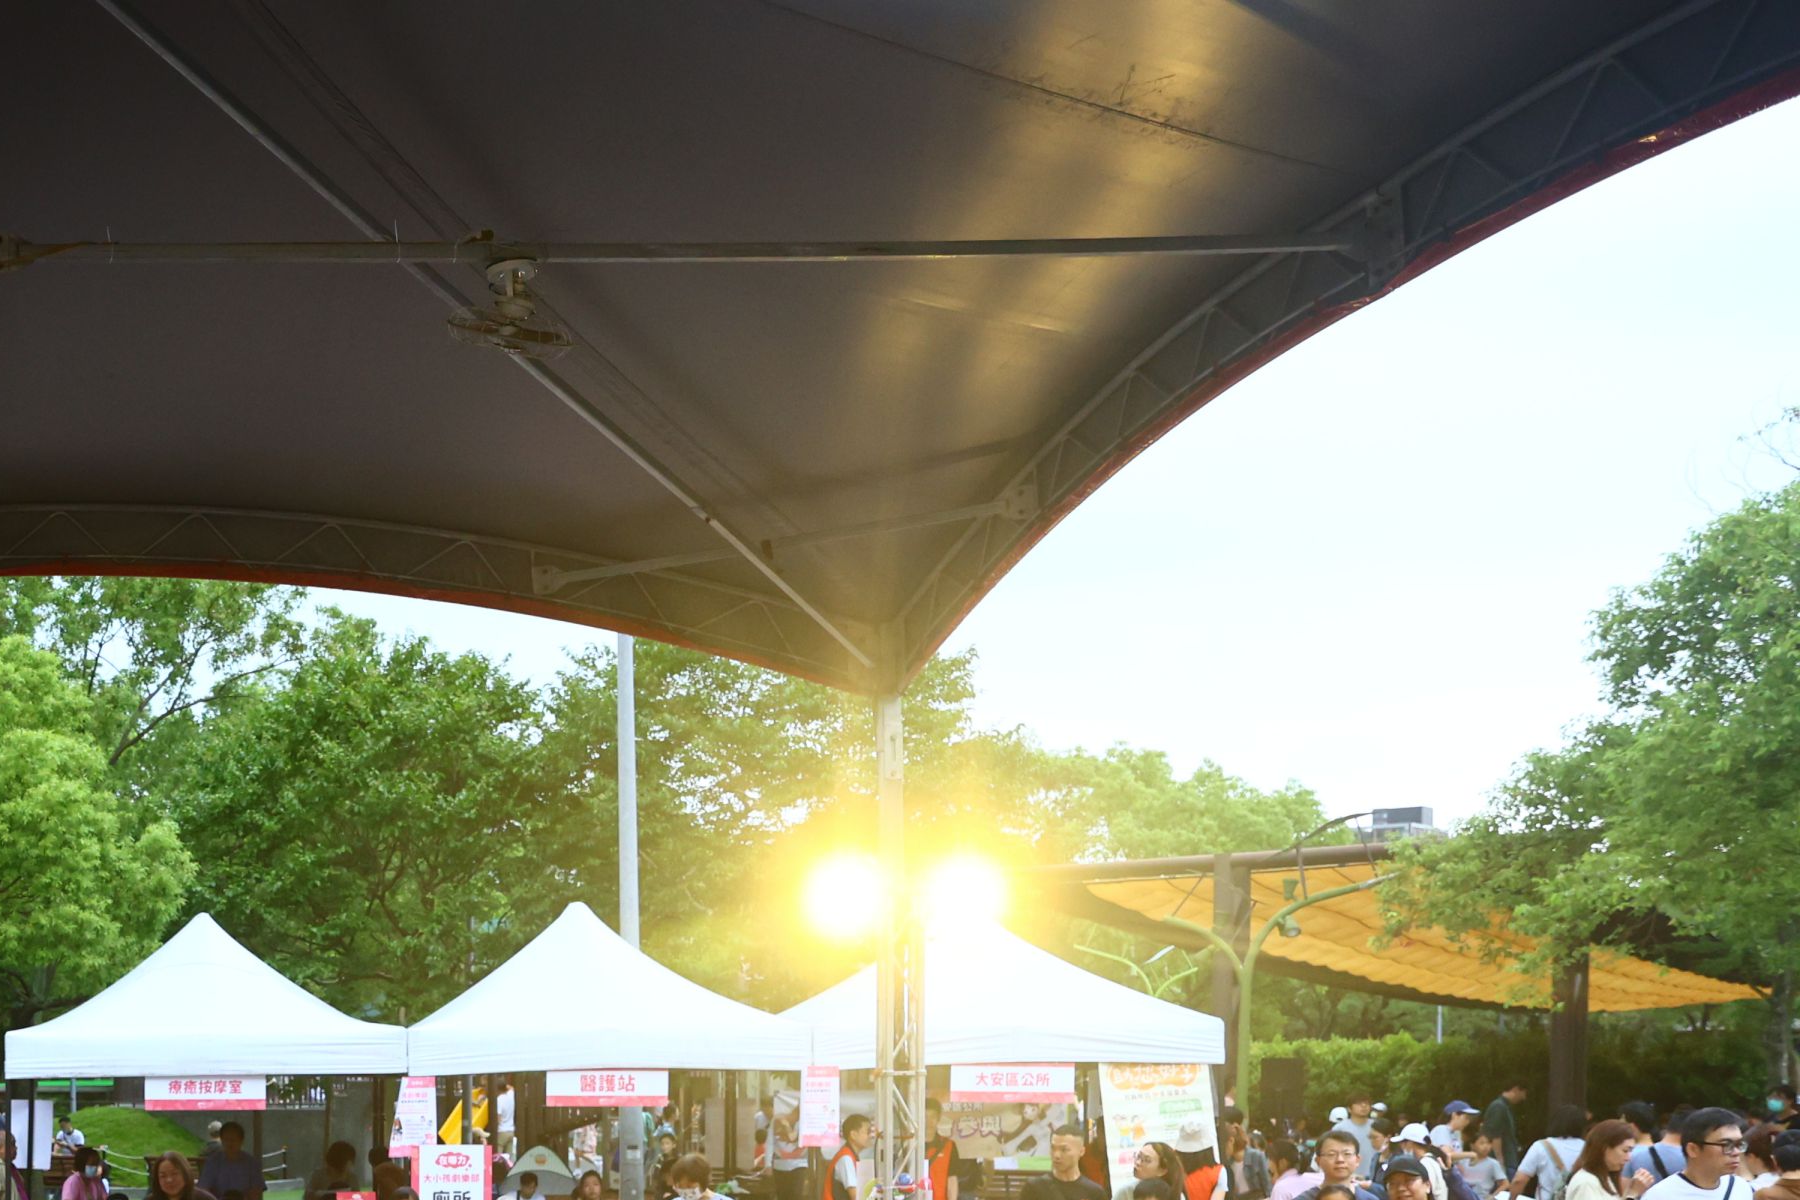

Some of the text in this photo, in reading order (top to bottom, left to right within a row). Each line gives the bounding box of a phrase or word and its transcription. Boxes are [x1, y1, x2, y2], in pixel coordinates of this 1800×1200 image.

[168, 1080, 242, 1094] 療癒按摩室
[580, 1075, 635, 1092] 醫護站
[975, 1072, 1051, 1087] 大安區公所
